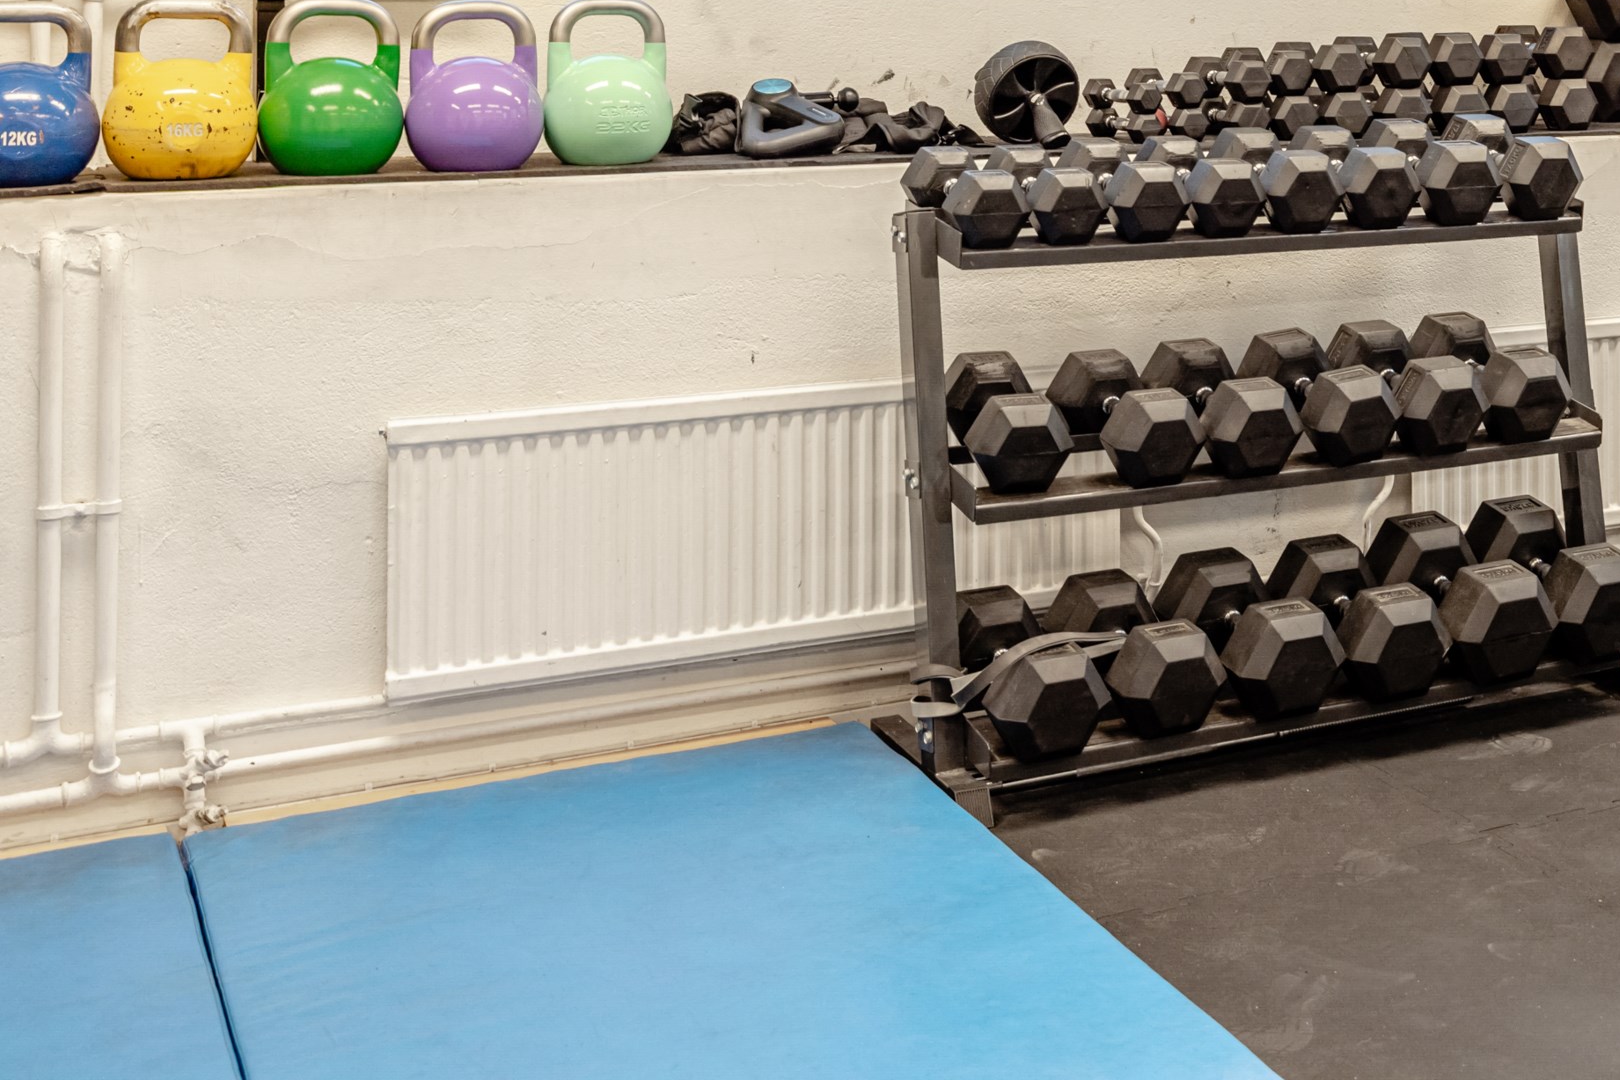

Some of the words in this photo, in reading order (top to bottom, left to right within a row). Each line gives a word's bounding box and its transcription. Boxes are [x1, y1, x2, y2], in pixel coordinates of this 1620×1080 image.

[166, 122, 204, 137] 16KG
[595, 119, 651, 135] 22KG
[0, 130, 37, 147] 12KG
